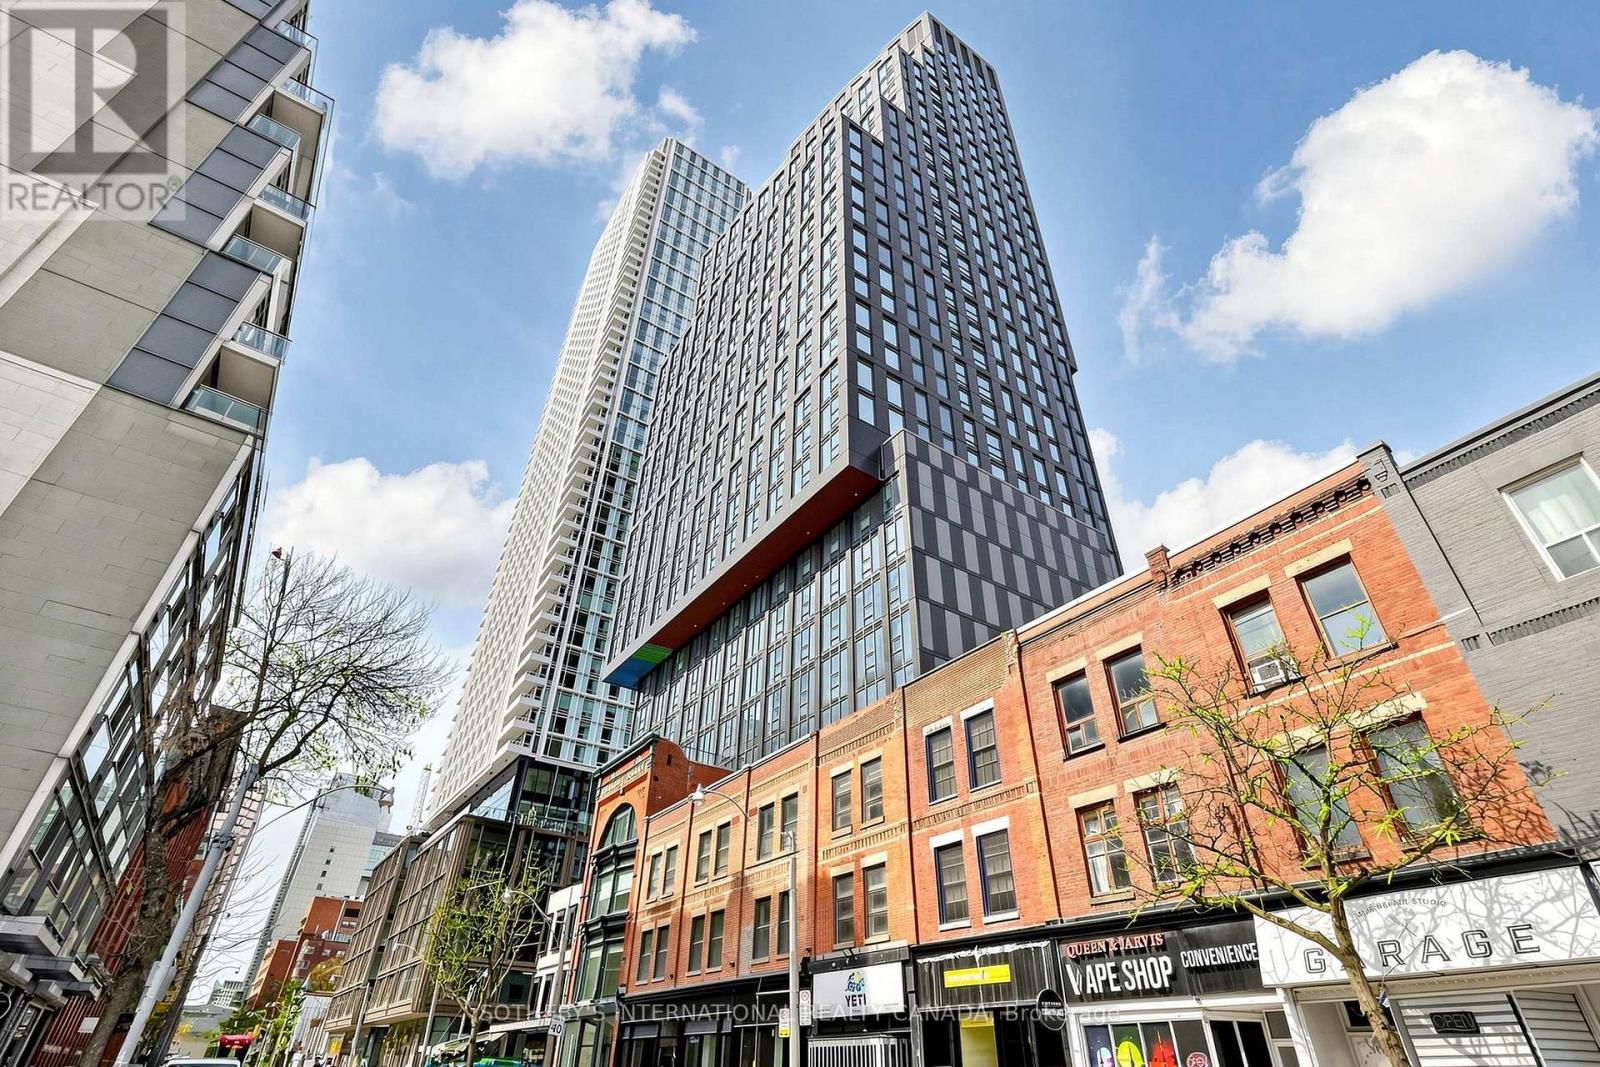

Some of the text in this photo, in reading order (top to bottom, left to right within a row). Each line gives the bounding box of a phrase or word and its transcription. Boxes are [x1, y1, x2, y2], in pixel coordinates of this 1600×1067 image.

[1066, 940, 1107, 959] QUEEN
[1118, 933, 1164, 950] JARVIS
[1180, 942, 1260, 968] CONVENIENCE
[1303, 923, 1541, 975] GRAGE
[1065, 955, 1173, 996] VAPE SHOP
[845, 993, 867, 1008] YETI
[550, 1023, 562, 1034] 40
[1432, 1013, 1476, 1029] OPEN
